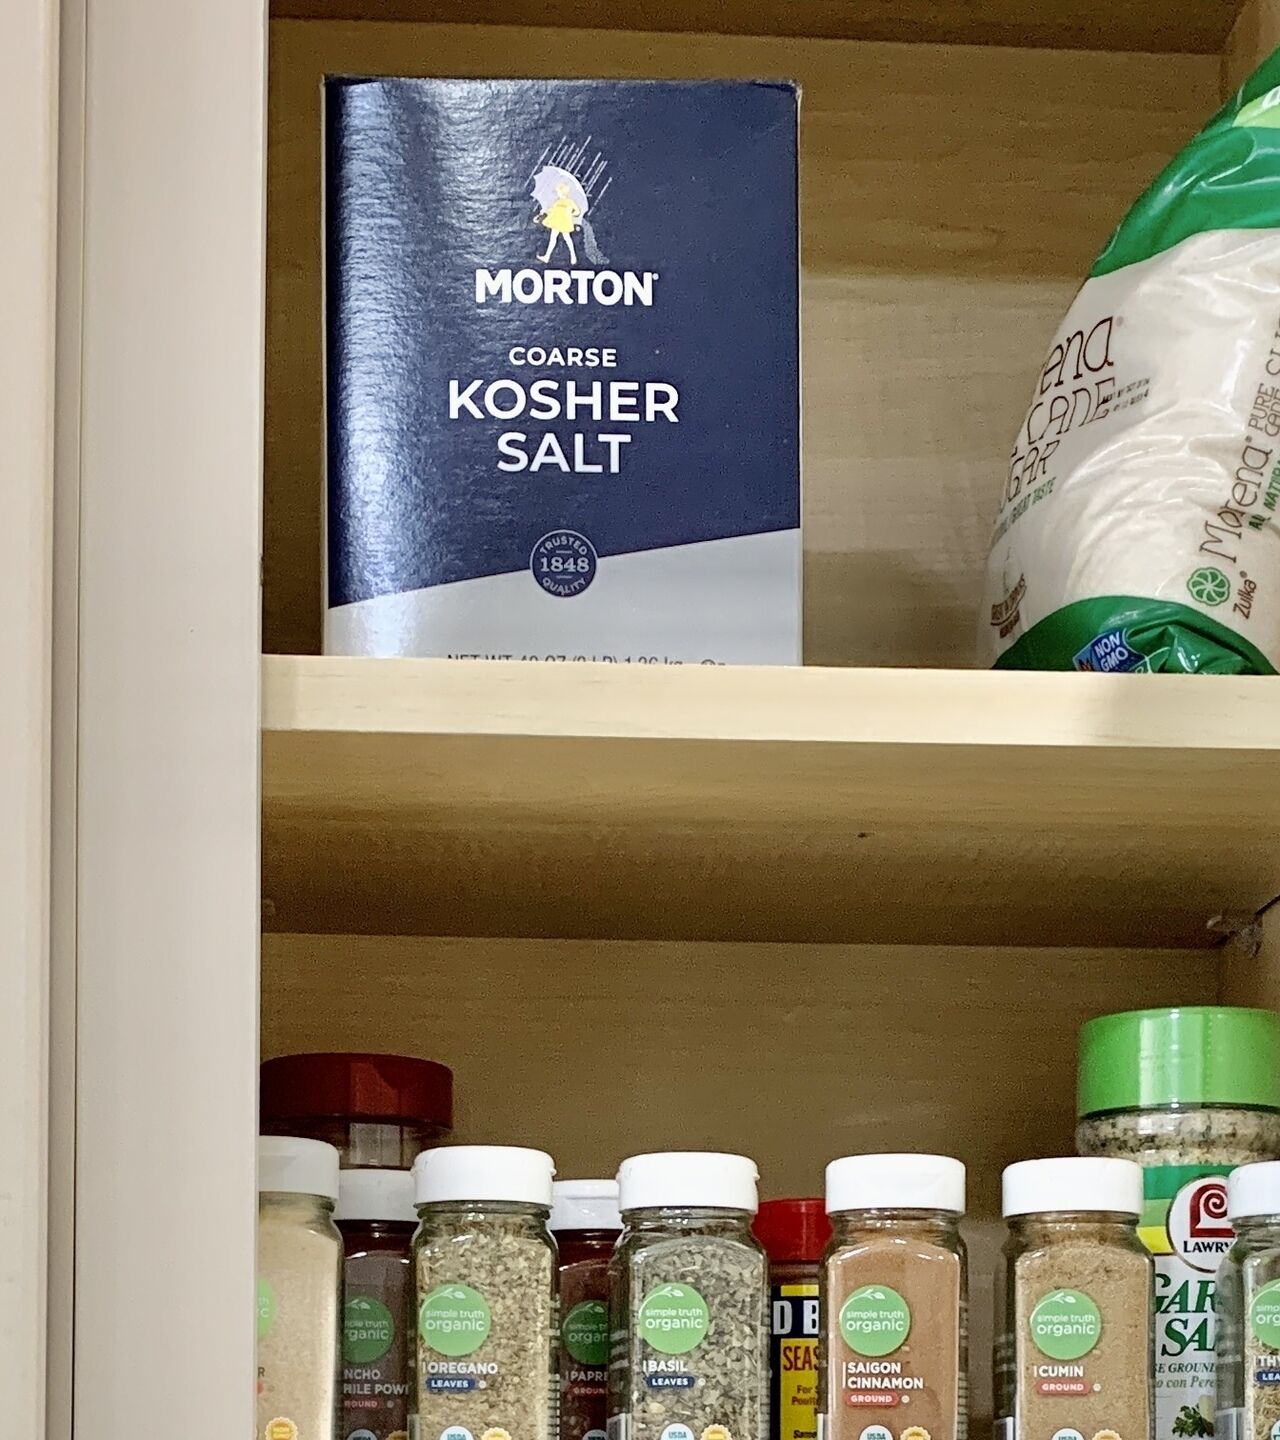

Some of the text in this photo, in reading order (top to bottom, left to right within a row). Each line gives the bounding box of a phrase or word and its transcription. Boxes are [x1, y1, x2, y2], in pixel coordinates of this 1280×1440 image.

[475, 268, 654, 306] MORTON
[509, 347, 617, 368] COARSE
[449, 379, 679, 423] KOSHER
[1248, 384, 1274, 431] PURE
[496, 433, 632, 474] SALT
[1199, 444, 1272, 563] Morena
[540, 536, 587, 554] TRUSTED
[540, 556, 590, 572] 1848
[542, 578, 586, 594] QUALITY
[1233, 578, 1256, 619] Zulka
[1095, 631, 1121, 656] NON
[1100, 648, 1128, 672] GMO
[426, 1310, 484, 1319] simple truth
[646, 1308, 702, 1317] simple truth
[846, 1311, 904, 1320] simple truth
[426, 1318, 484, 1332] organic
[646, 1317, 703, 1331] organic
[1038, 1314, 1095, 1324] simple truth
[846, 1319, 904, 1333] organic
[1037, 1323, 1094, 1336] organic
[428, 1362, 498, 1374] OREGANO
[648, 1360, 687, 1372] BASIL
[848, 1362, 901, 1374] SAIGON
[1039, 1366, 1083, 1377] CUMIN
[431, 1380, 468, 1388] LEAVES
[652, 1378, 688, 1386] LEAVES
[848, 1377, 923, 1389] CINNAMON
[1042, 1383, 1084, 1391] GROUND
[1172, 1377, 1187, 1388] con
[375, 1384, 408, 1395] POW
[850, 1395, 892, 1403] GROUND
[867, 1432, 886, 1440] USDA
